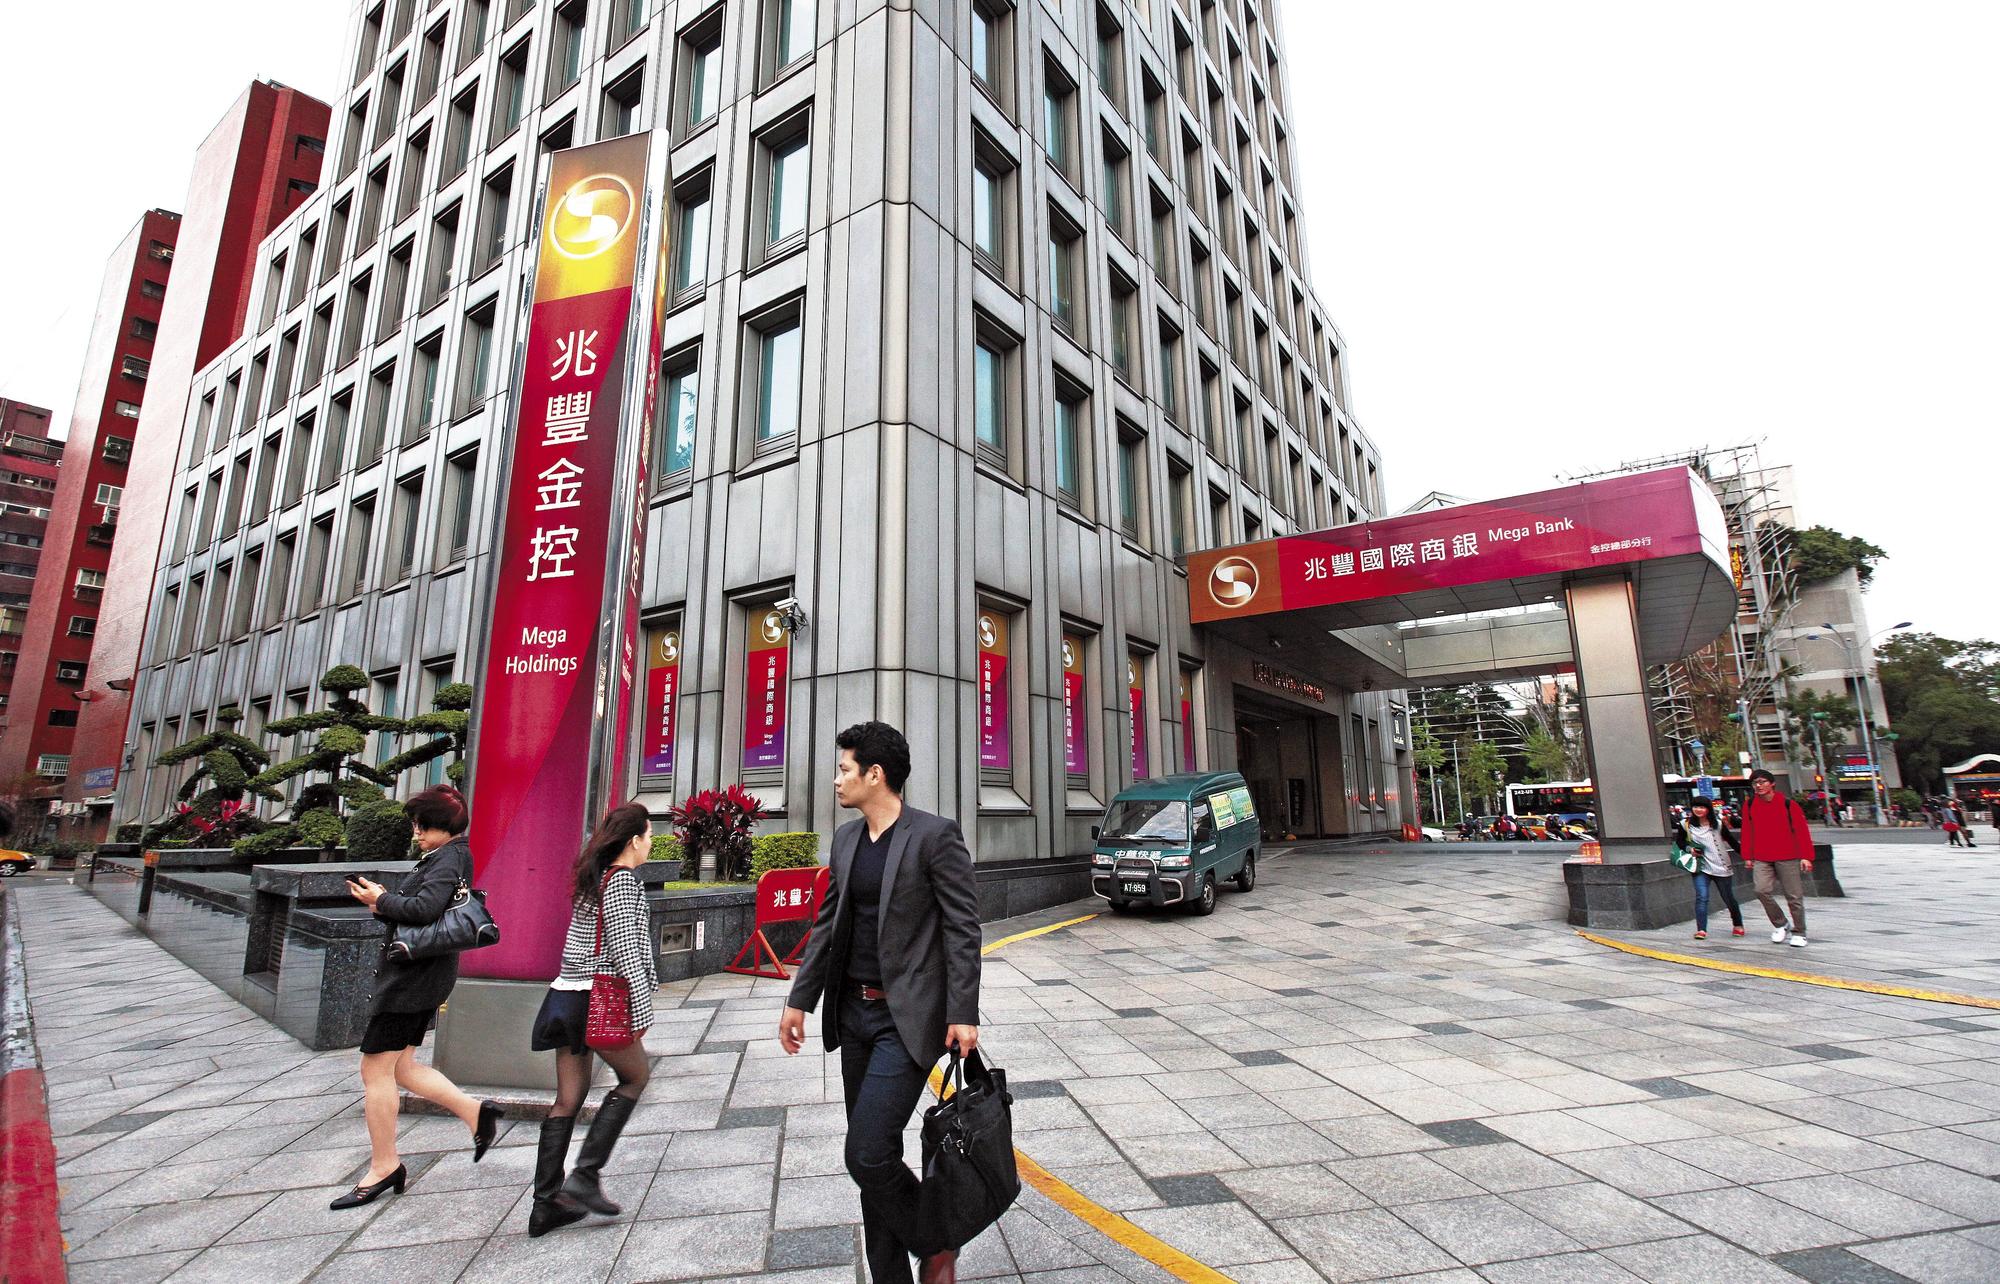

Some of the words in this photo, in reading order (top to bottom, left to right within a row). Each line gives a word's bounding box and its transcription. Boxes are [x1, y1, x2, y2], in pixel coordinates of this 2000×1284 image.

[526, 328, 598, 583] 兆豐金控
[1488, 527, 1530, 542] Mega
[1535, 517, 1574, 535] Bank
[1304, 532, 1479, 581] 兆豐國際商銀
[521, 626, 567, 649] Mega
[505, 654, 577, 676] Holdings
